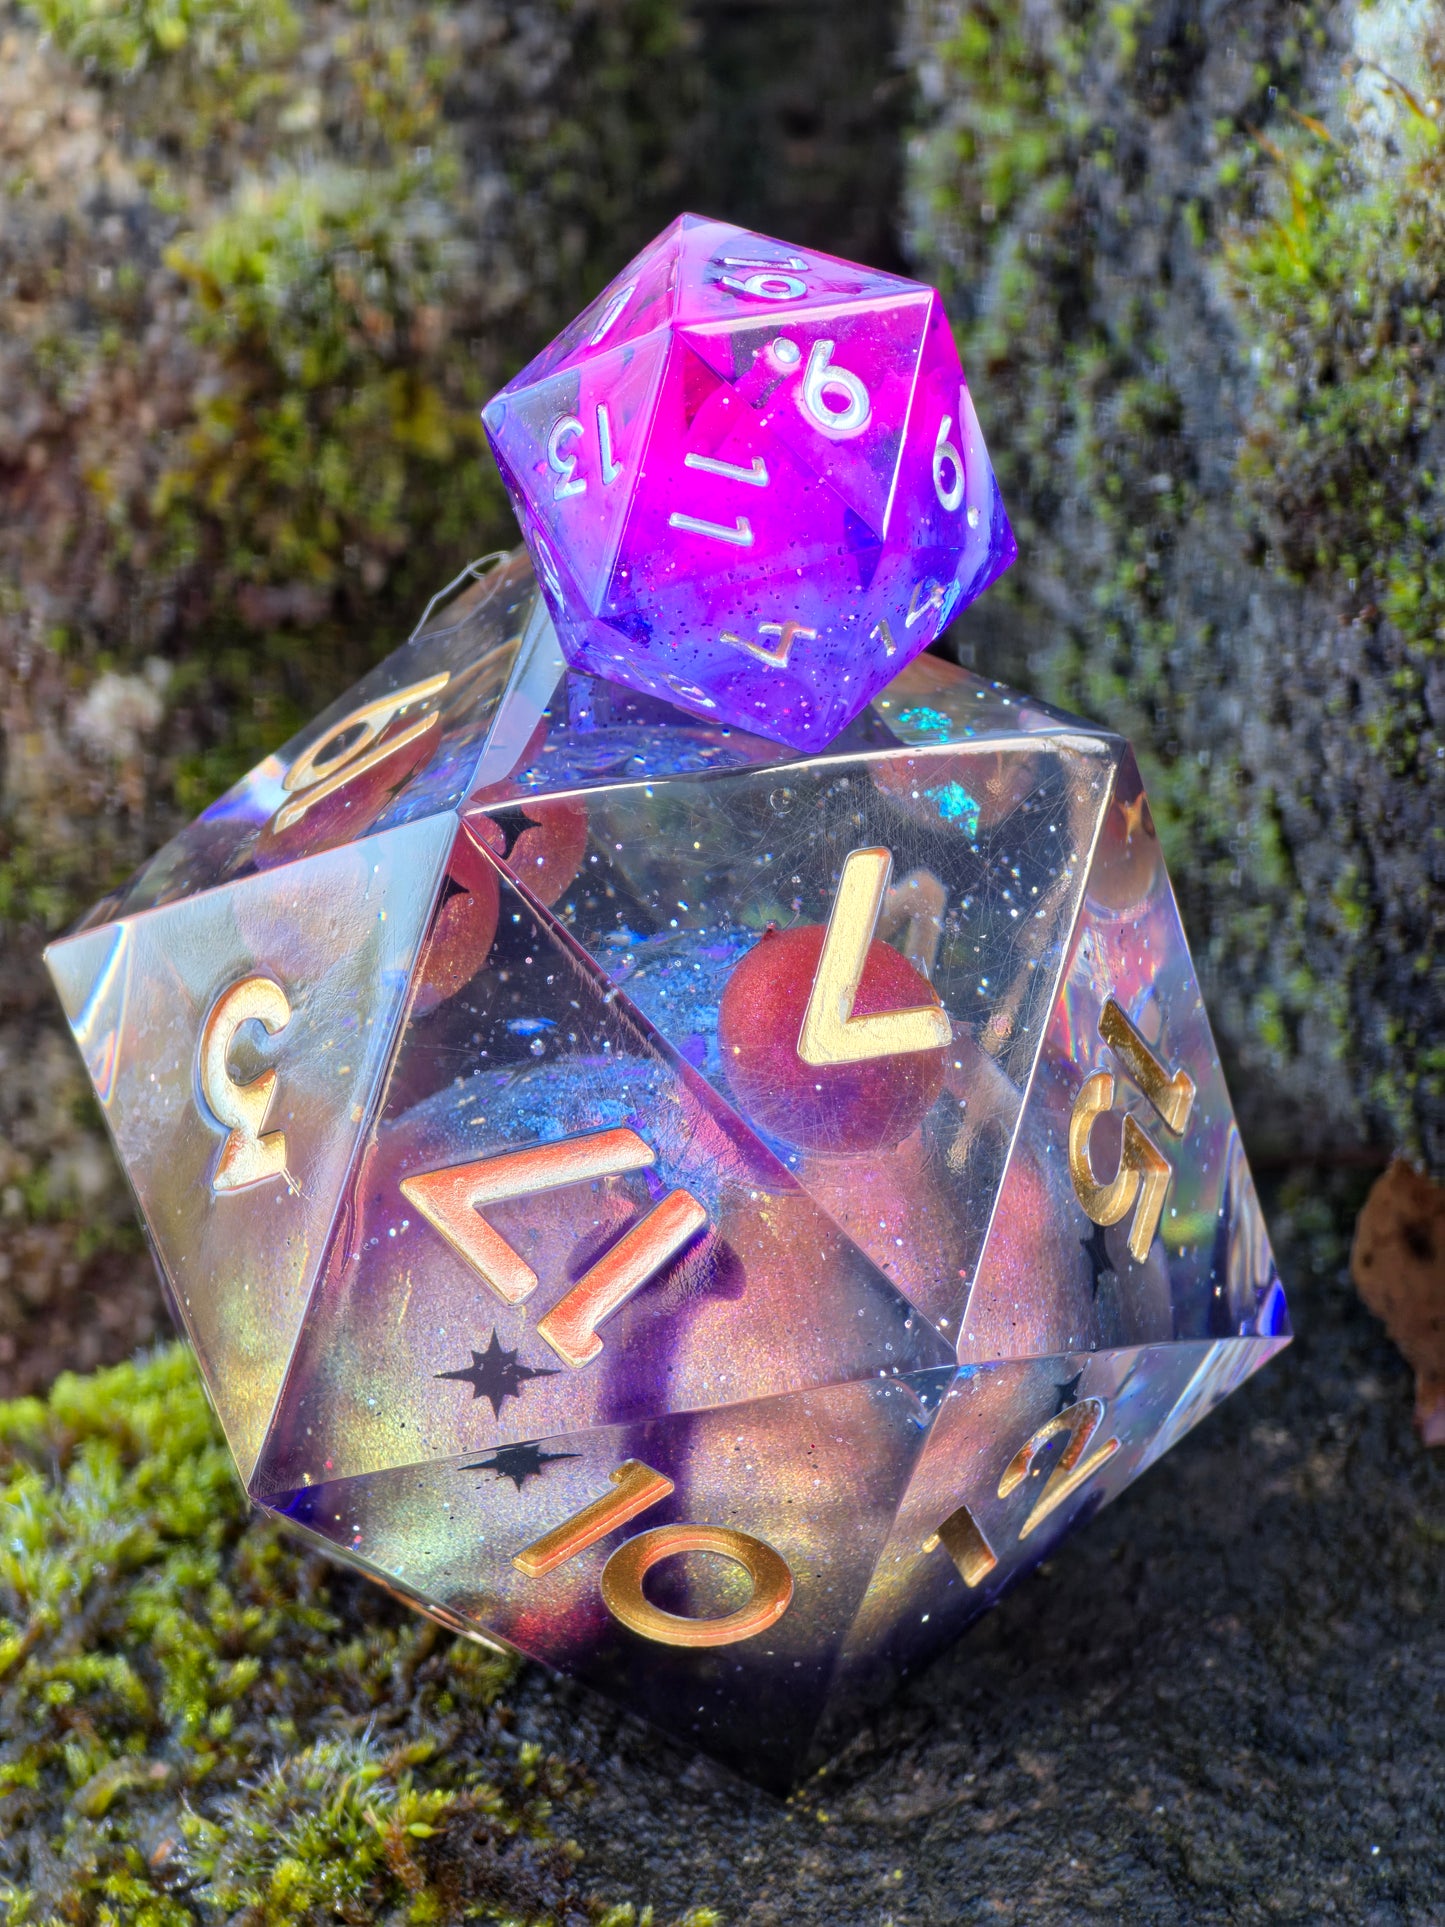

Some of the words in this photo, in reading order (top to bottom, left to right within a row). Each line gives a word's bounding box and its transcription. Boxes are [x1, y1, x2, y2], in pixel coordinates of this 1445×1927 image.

[668, 452, 771, 548] 11
[400, 1127, 708, 1368] 17
[511, 1457, 796, 1648] 10
